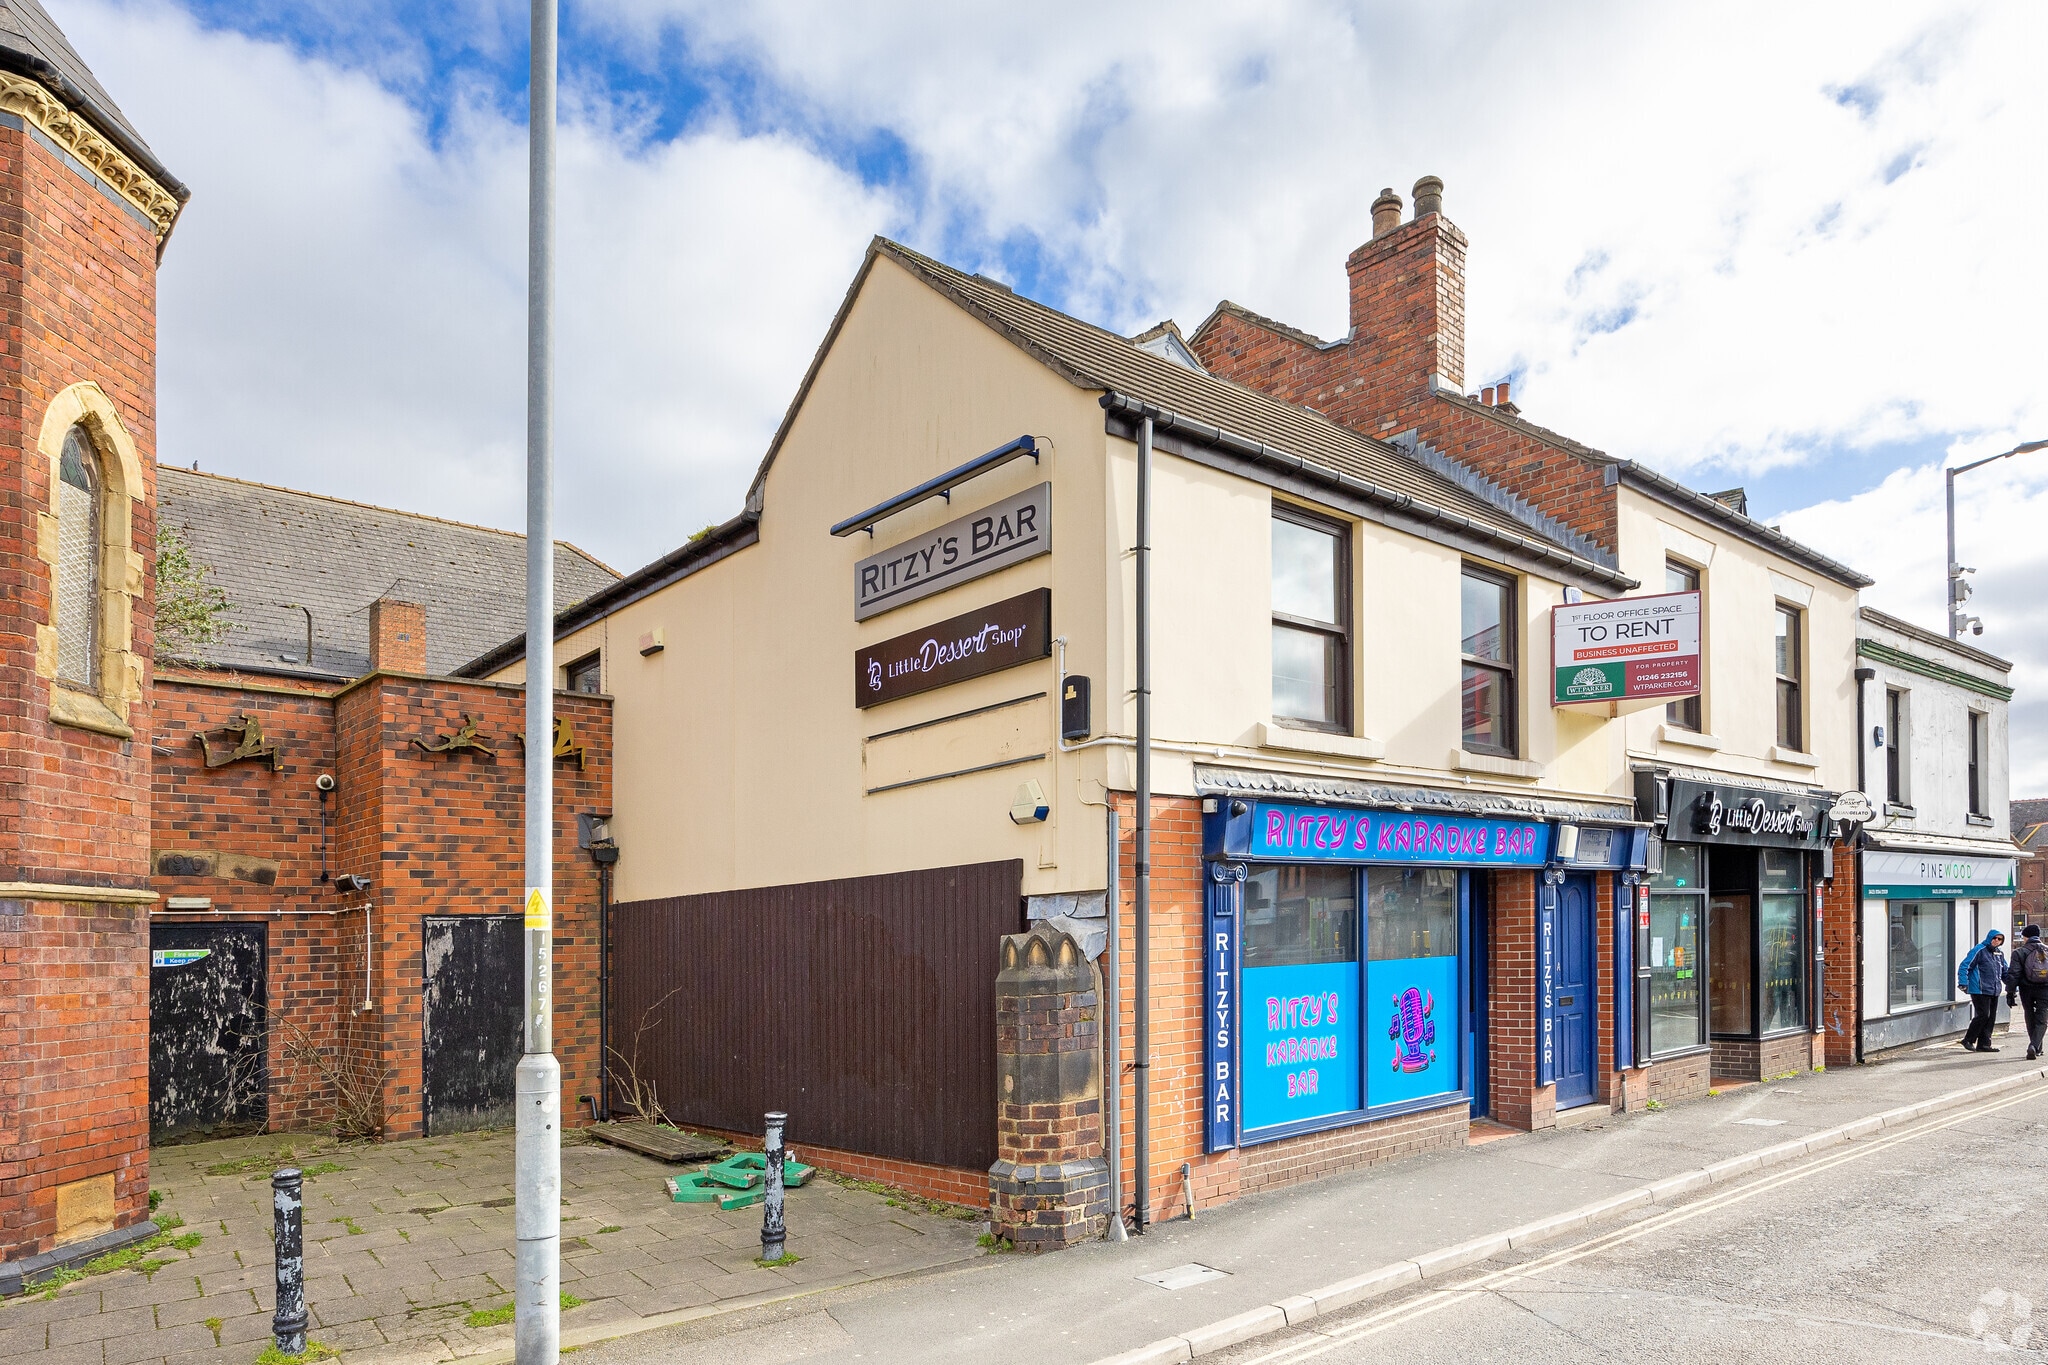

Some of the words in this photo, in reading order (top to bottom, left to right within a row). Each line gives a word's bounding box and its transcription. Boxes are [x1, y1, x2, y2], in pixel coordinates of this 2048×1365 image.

[861, 536, 959, 598] RITZY'S
[971, 504, 1037, 555] BAR
[1583, 612, 1614, 621] FLOOR
[1617, 608, 1649, 618] OFFICE
[1652, 604, 1682, 614] SPACE
[1578, 626, 1607, 642] TO
[1616, 618, 1675, 639] RENT
[888, 656, 921, 679] Little
[919, 623, 1000, 673] Dessert
[1576, 649, 1617, 659] BUSINESS
[1619, 642, 1676, 655] UNAFFECTED
[1653, 660, 1688, 668] PROPERTY
[1633, 680, 1692, 691] WTPARKER.COM
[1637, 672, 1659, 682] 01246
[1661, 670, 1688, 679] 232156
[1266, 809, 1370, 850] RITZY'S
[1377, 821, 1487, 854] KARAOKE
[1494, 827, 1536, 856] BAR
[1726, 808, 1752, 828] Little
[1750, 798, 1803, 834] Dessert
[1796, 818, 1813, 840] Shop
[1920, 863, 1972, 879] PINEWOOD
[1543, 922, 1552, 1008] RITZY'S
[1215, 932, 1229, 1048] RITZY'S
[1267, 992, 1338, 1030] RITZY'S
[1266, 1036, 1337, 1066] KARAOKE
[1544, 1018, 1553, 1064] BAR
[1216, 1061, 1230, 1123] BAR
[1287, 1069, 1319, 1098] BAR
